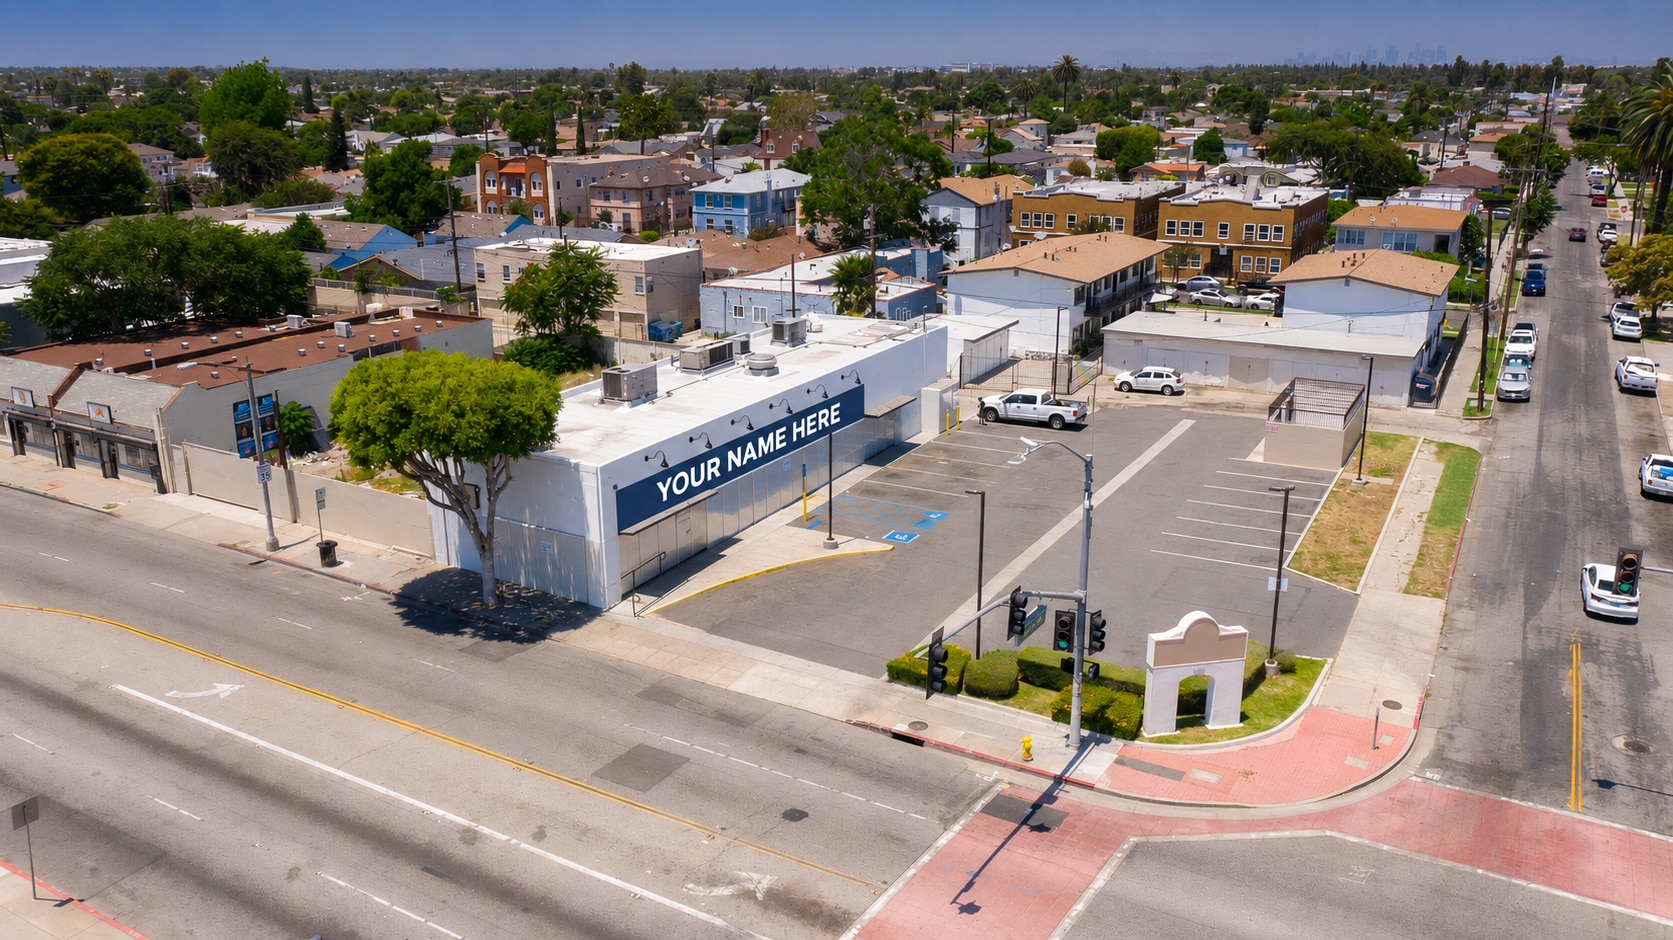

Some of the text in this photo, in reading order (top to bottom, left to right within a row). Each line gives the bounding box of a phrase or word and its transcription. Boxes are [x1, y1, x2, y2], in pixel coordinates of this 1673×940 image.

[656, 402, 841, 502] YOUR NAME HERE
